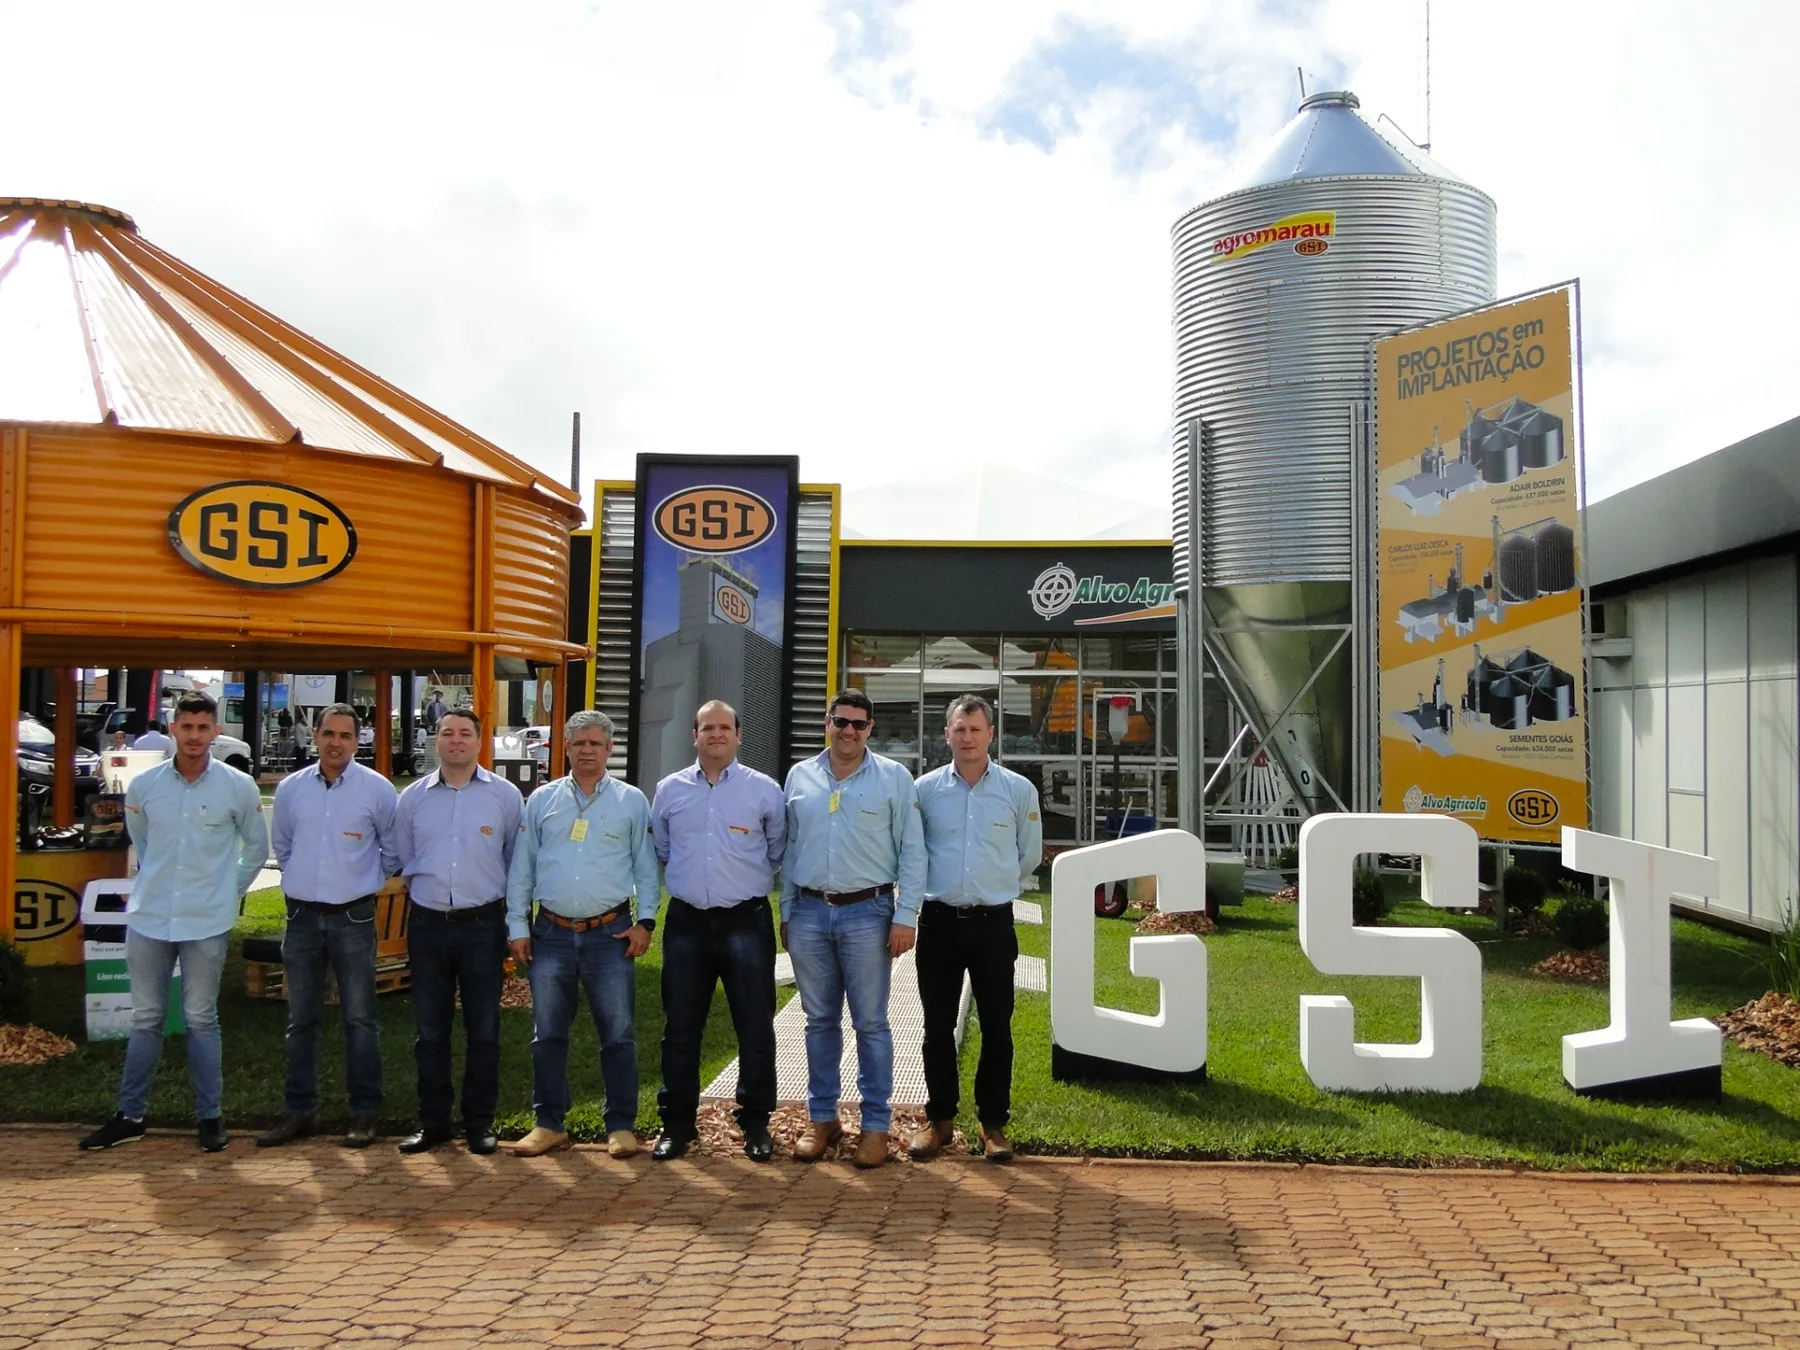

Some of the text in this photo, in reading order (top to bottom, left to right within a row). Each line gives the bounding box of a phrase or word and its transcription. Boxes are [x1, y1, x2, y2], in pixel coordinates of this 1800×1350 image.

[1213, 222, 1331, 256] agromarau
[1299, 241, 1324, 253] GSI
[1397, 318, 1544, 378] PROJETOS em
[1397, 343, 1545, 400] IMPLANTAÇÃO
[1509, 477, 1565, 493] ADAIR BOLDRIN
[200, 501, 329, 569] GSI
[672, 500, 755, 540] GSI
[721, 591, 746, 619] GSI
[1073, 576, 1130, 603] Alvo
[1509, 733, 1574, 743] SEMENTES GOIÁS
[1515, 797, 1550, 818] GSI
[14, 891, 66, 930] SI
[1051, 811, 1723, 1094] GSI
